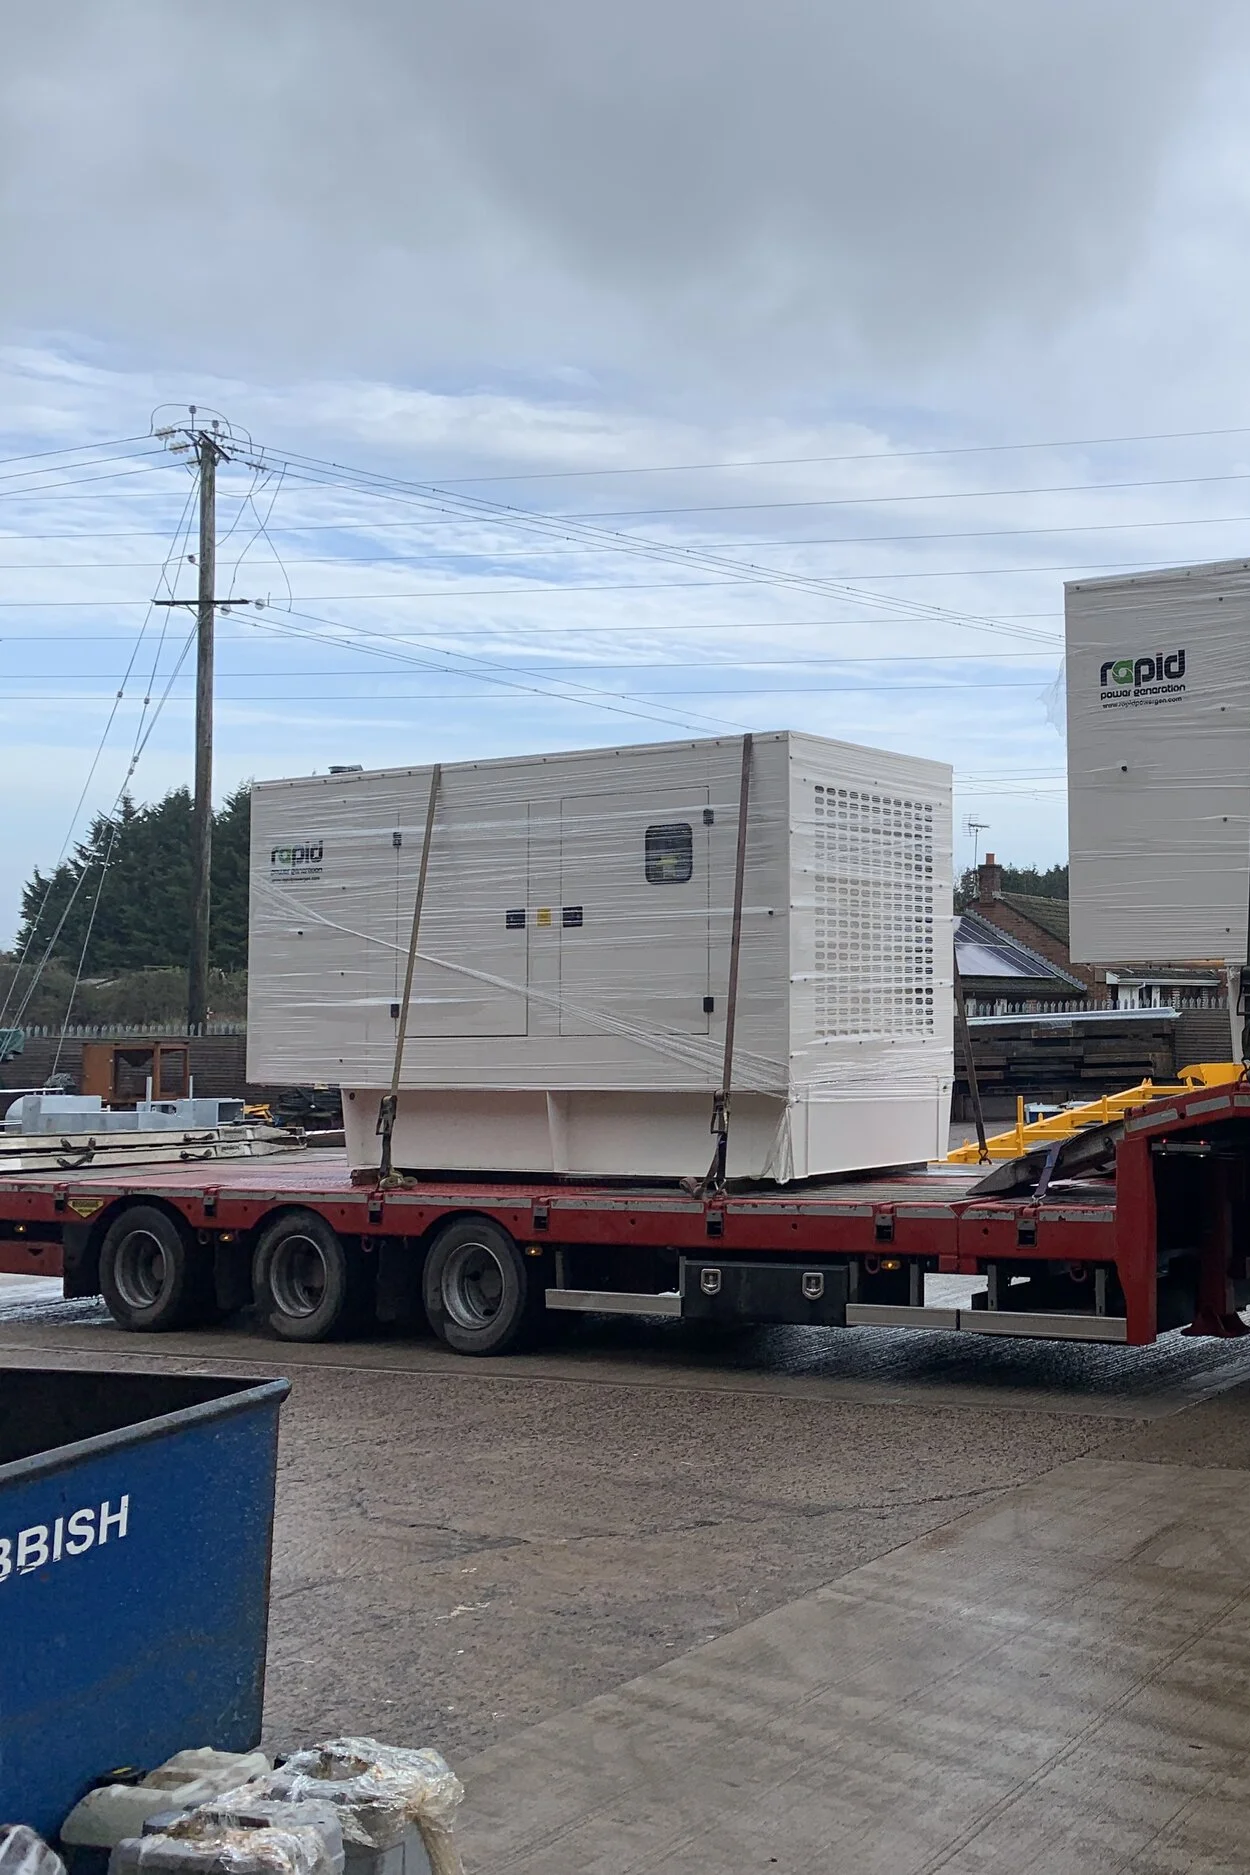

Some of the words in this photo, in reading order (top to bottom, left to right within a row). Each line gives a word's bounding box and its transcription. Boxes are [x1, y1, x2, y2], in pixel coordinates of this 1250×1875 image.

[1100, 649, 1186, 687] rapid
[1100, 689, 1132, 701] power
[1133, 684, 1186, 697] generation
[271, 840, 324, 867] rapid
